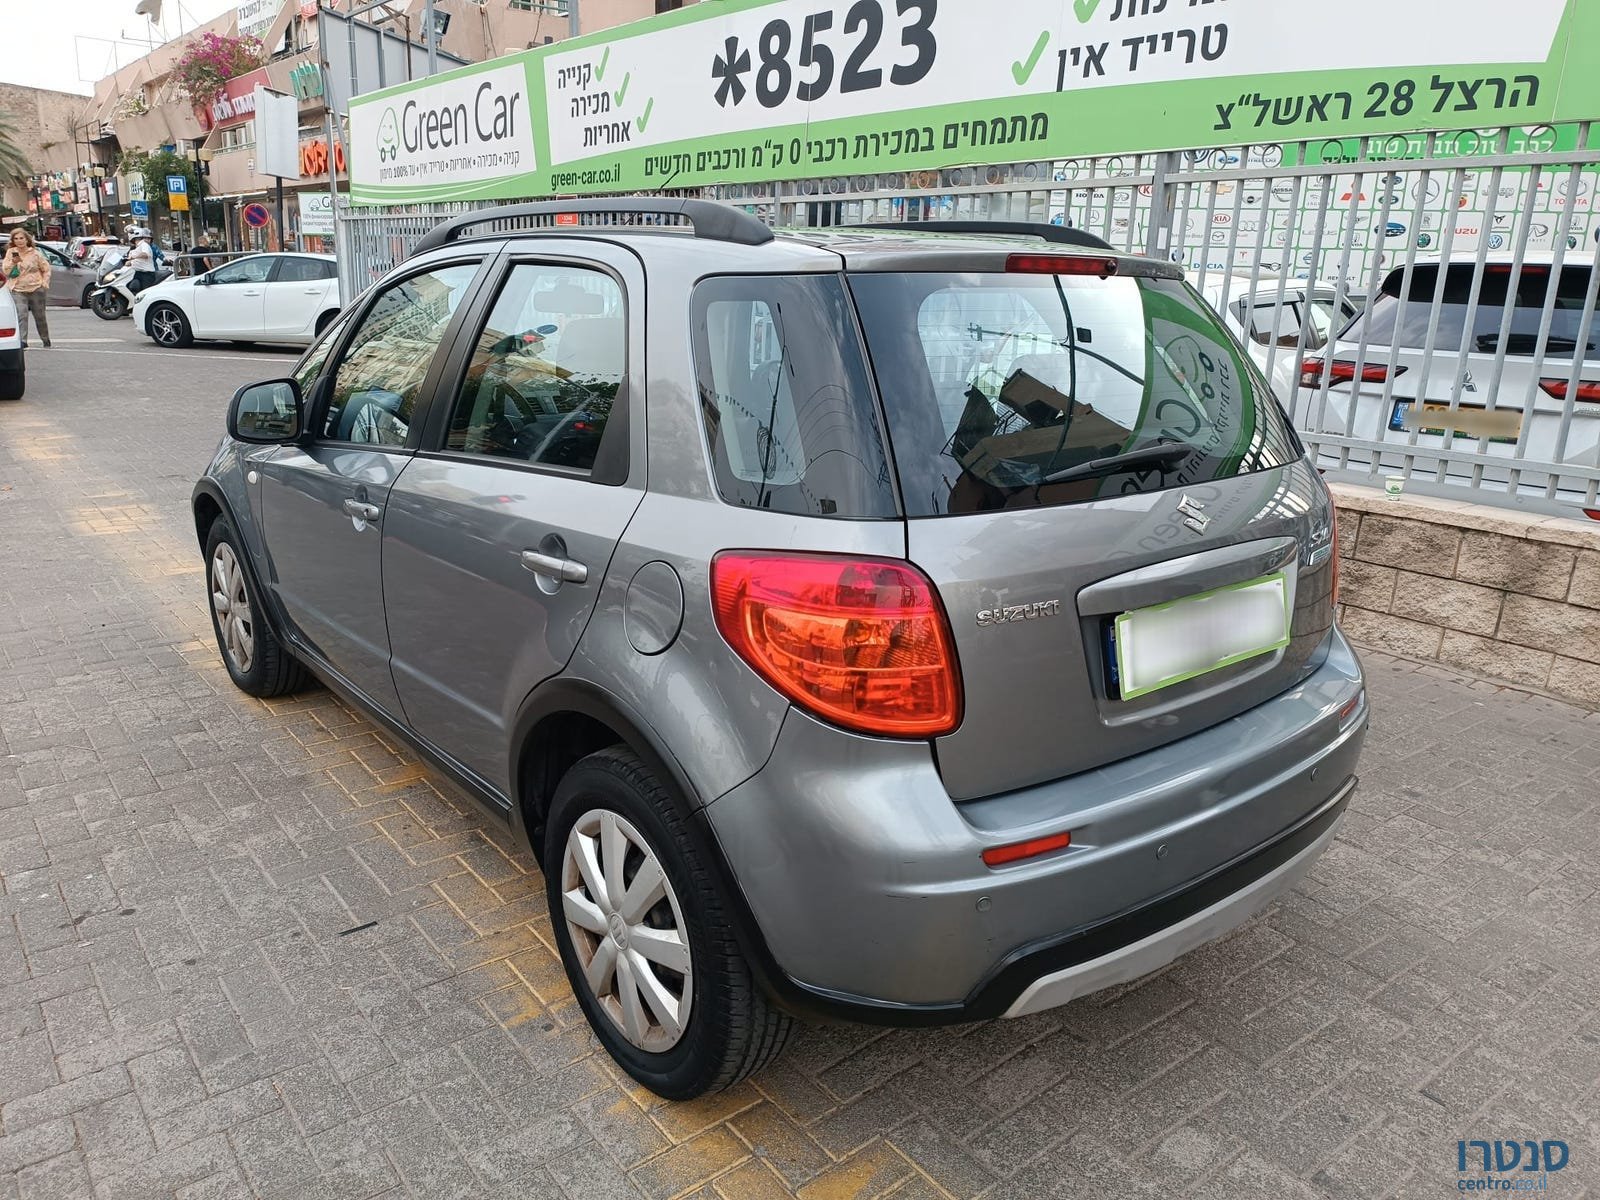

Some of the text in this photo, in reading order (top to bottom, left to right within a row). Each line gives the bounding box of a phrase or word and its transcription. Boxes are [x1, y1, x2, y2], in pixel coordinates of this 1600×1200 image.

[1055, 23, 1228, 92] טרייד אין
[558, 62, 591, 90] קנייה
[570, 92, 610, 118] מכירה
[1364, 79, 1415, 119] 28
[1430, 74, 1539, 113] הרצל
[402, 81, 520, 153] Green Car
[583, 120, 631, 147] אחריות
[852, 126, 935, 159] במכירת
[943, 112, 1049, 149] מתמחים
[477, 153, 498, 168] מכירה
[503, 150, 520, 169] קניה
[696, 147, 746, 171] ורכבים
[789, 138, 801, 165] 0
[806, 136, 848, 164] רכבי
[393, 165, 409, 178] 100%
[428, 160, 445, 173] טרייד
[450, 156, 472, 171] אחריות
[644, 153, 691, 176] חדשים
[551, 165, 621, 190] green-car.co.il
[1482, 185, 1515, 198] Jep
[1214, 214, 1228, 222] KIA
[975, 598, 1061, 627] SUZUKI
